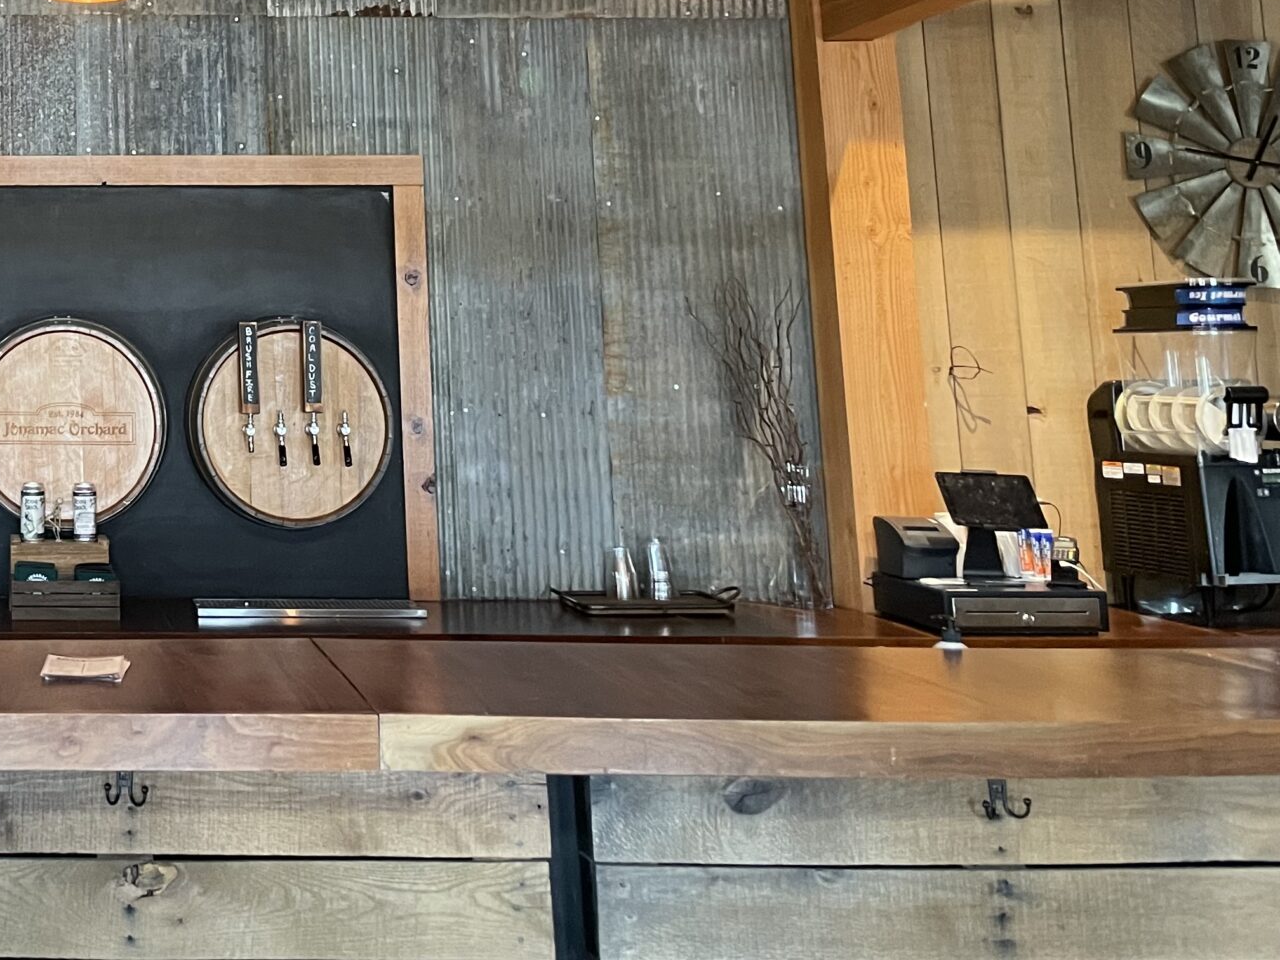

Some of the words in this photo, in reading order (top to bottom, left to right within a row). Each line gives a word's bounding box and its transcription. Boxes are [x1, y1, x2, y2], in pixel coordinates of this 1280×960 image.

[1233, 46, 1261, 69] 12
[1134, 141, 1153, 169] 9
[1250, 254, 1269, 283] 6
[3, 421, 65, 438] Jonamac
[69, 420, 128, 438] Orchard
